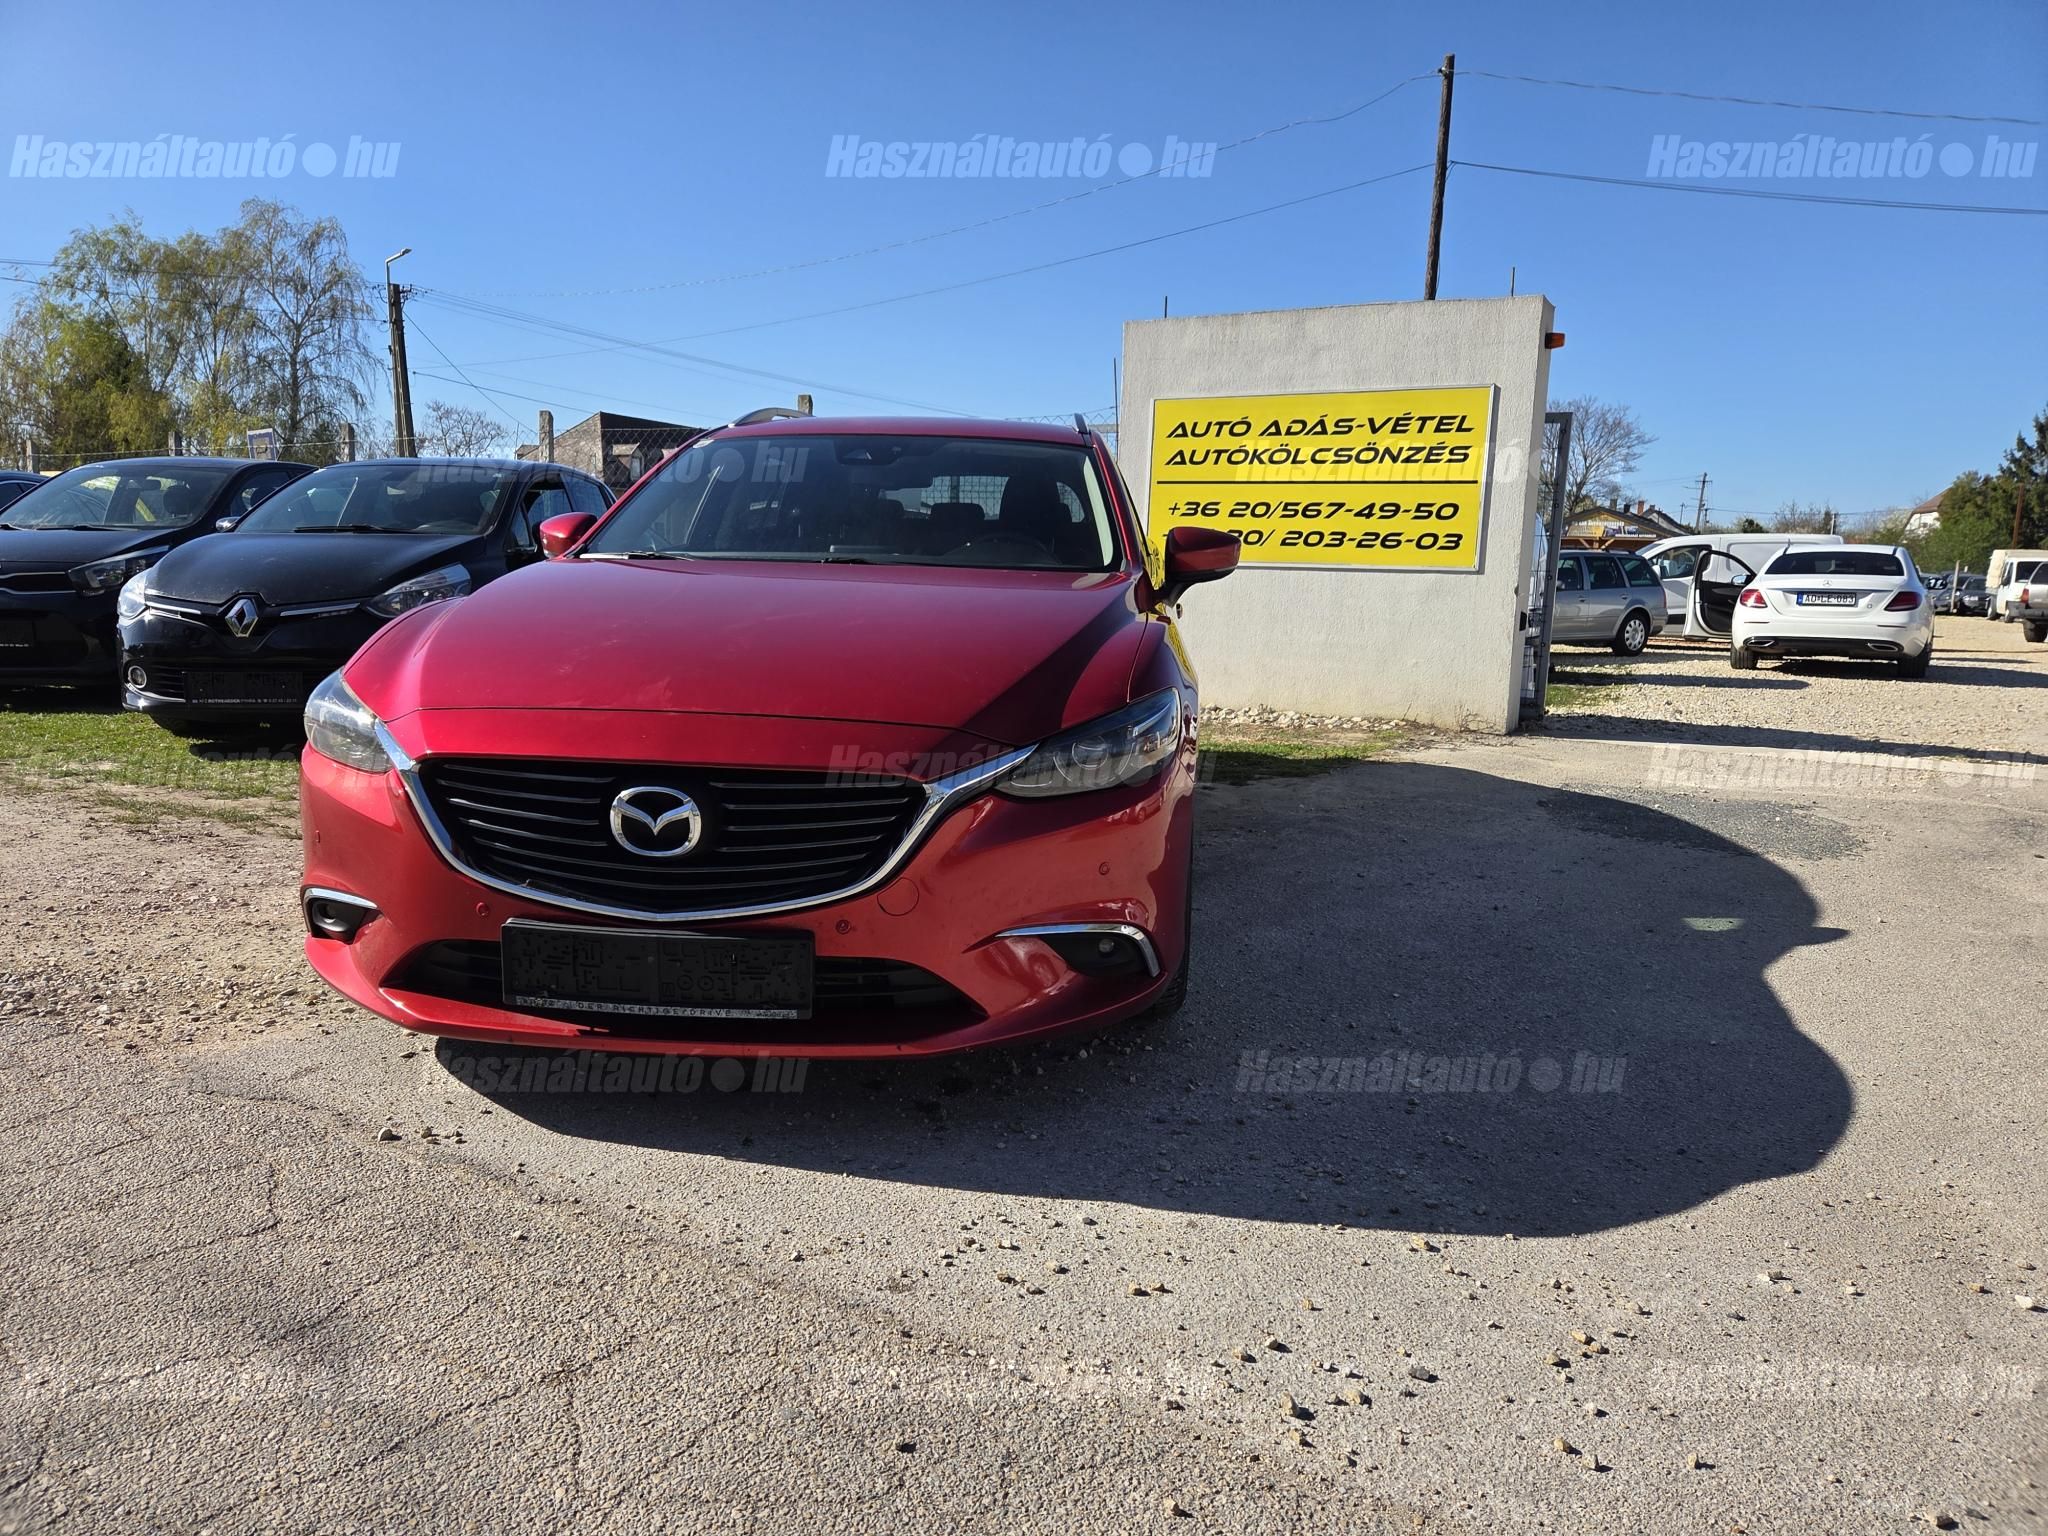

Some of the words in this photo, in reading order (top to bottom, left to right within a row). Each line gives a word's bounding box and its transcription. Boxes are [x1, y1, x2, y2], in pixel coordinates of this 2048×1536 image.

[1166, 416, 1252, 438] AUTÓ
[1258, 411, 1475, 437] ADÁS-VÉTEL
[1164, 441, 1473, 466] AUTÓKÖLCSÖNZÉS
[1168, 501, 1222, 517] +36
[1228, 501, 1460, 521] 20/567-49-50
[1280, 530, 1464, 551] 203-26-03
